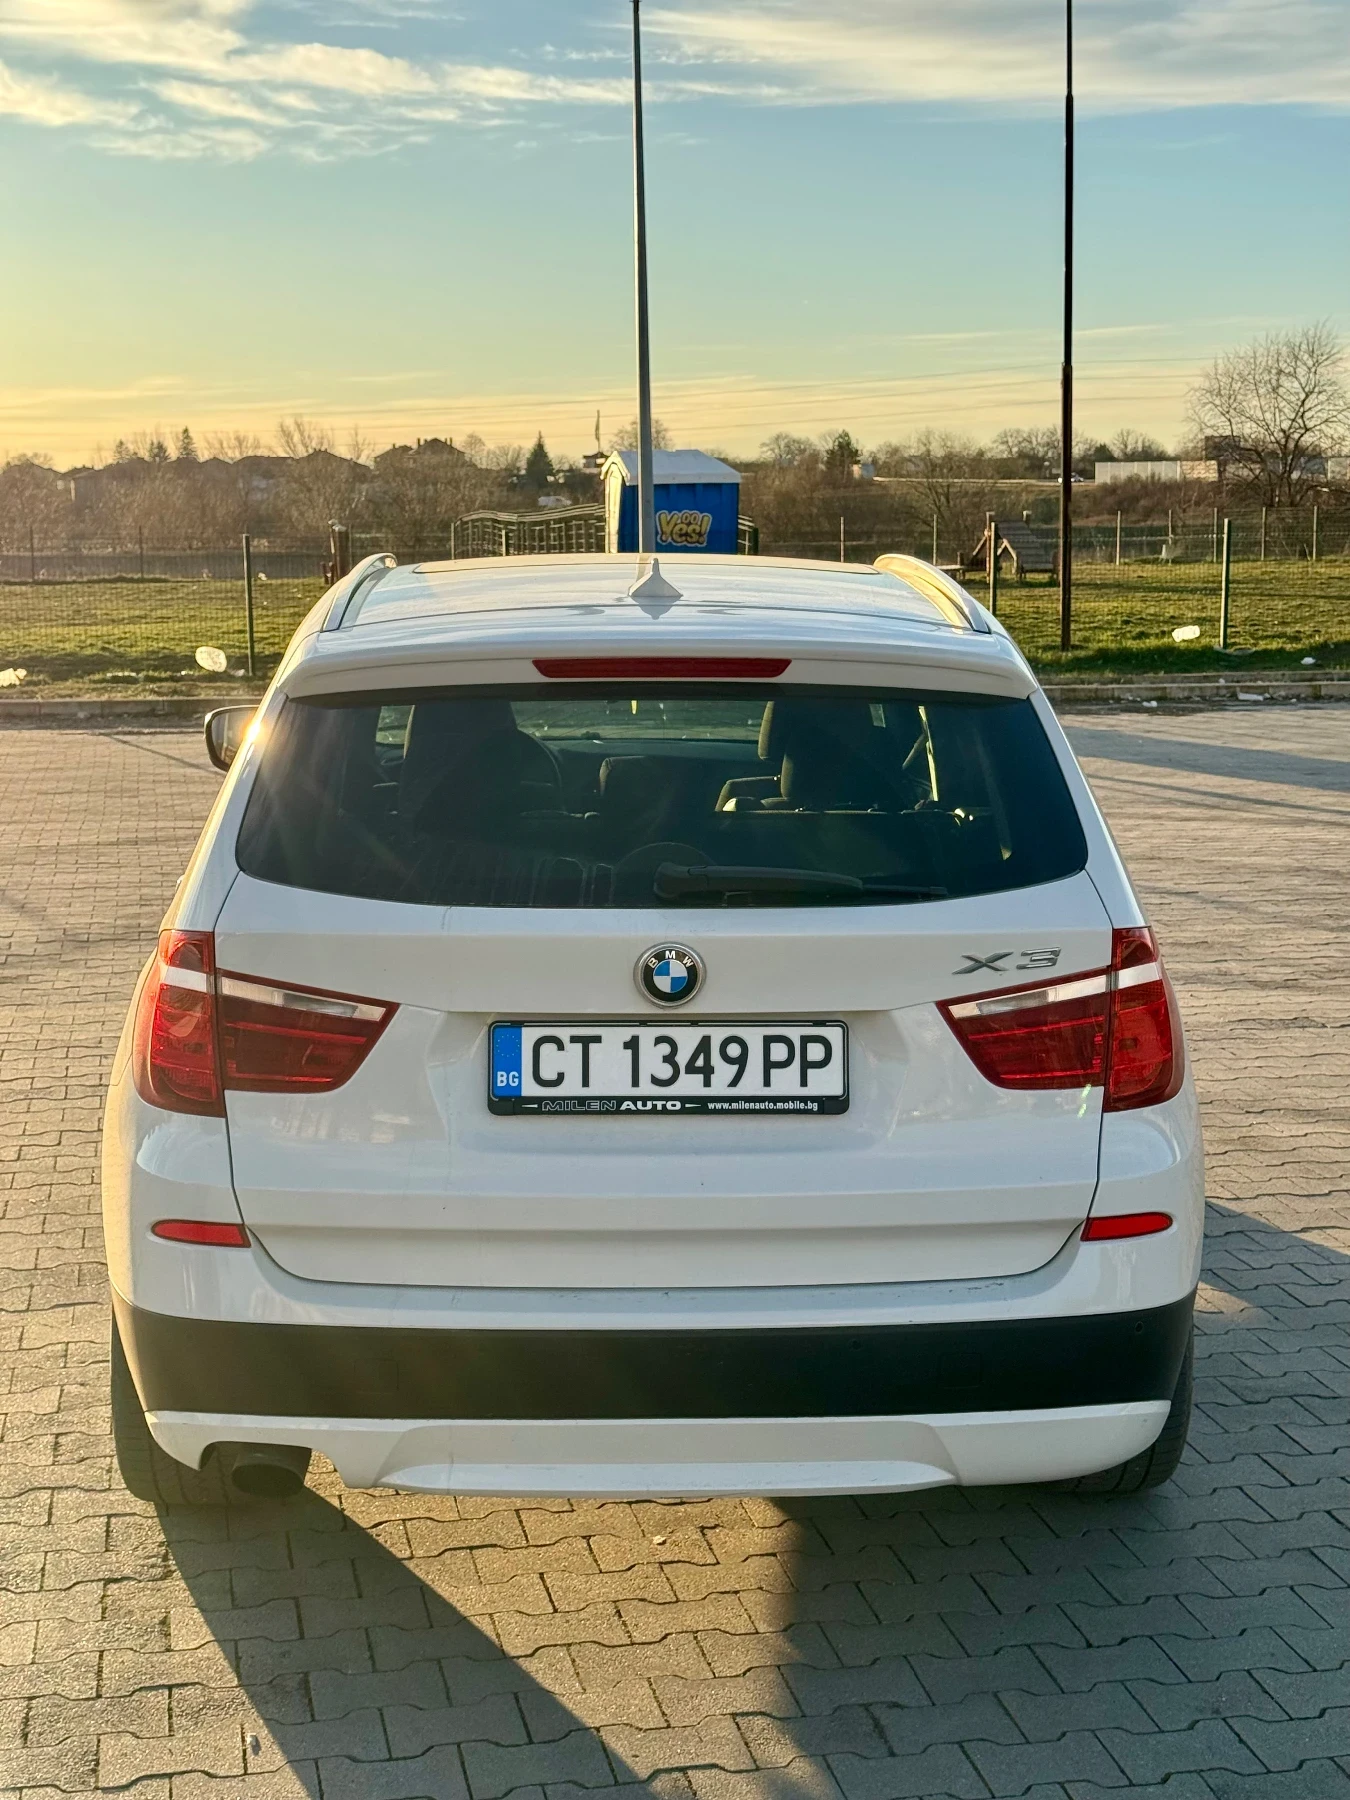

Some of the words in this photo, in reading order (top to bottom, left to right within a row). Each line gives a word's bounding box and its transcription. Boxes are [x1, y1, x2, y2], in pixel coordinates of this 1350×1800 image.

[656, 511, 711, 546] Yes!
[647, 950, 694, 968] BMW
[951, 946, 1061, 975] X3
[532, 1035, 602, 1087] CT
[623, 1035, 749, 1087] 1349
[762, 1035, 832, 1087] PP
[497, 1072, 519, 1086] BG
[542, 1101, 616, 1111] MILEN
[620, 1101, 681, 1111] AUTO
[707, 1101, 818, 1111] www.milenauto.mobile.bg
